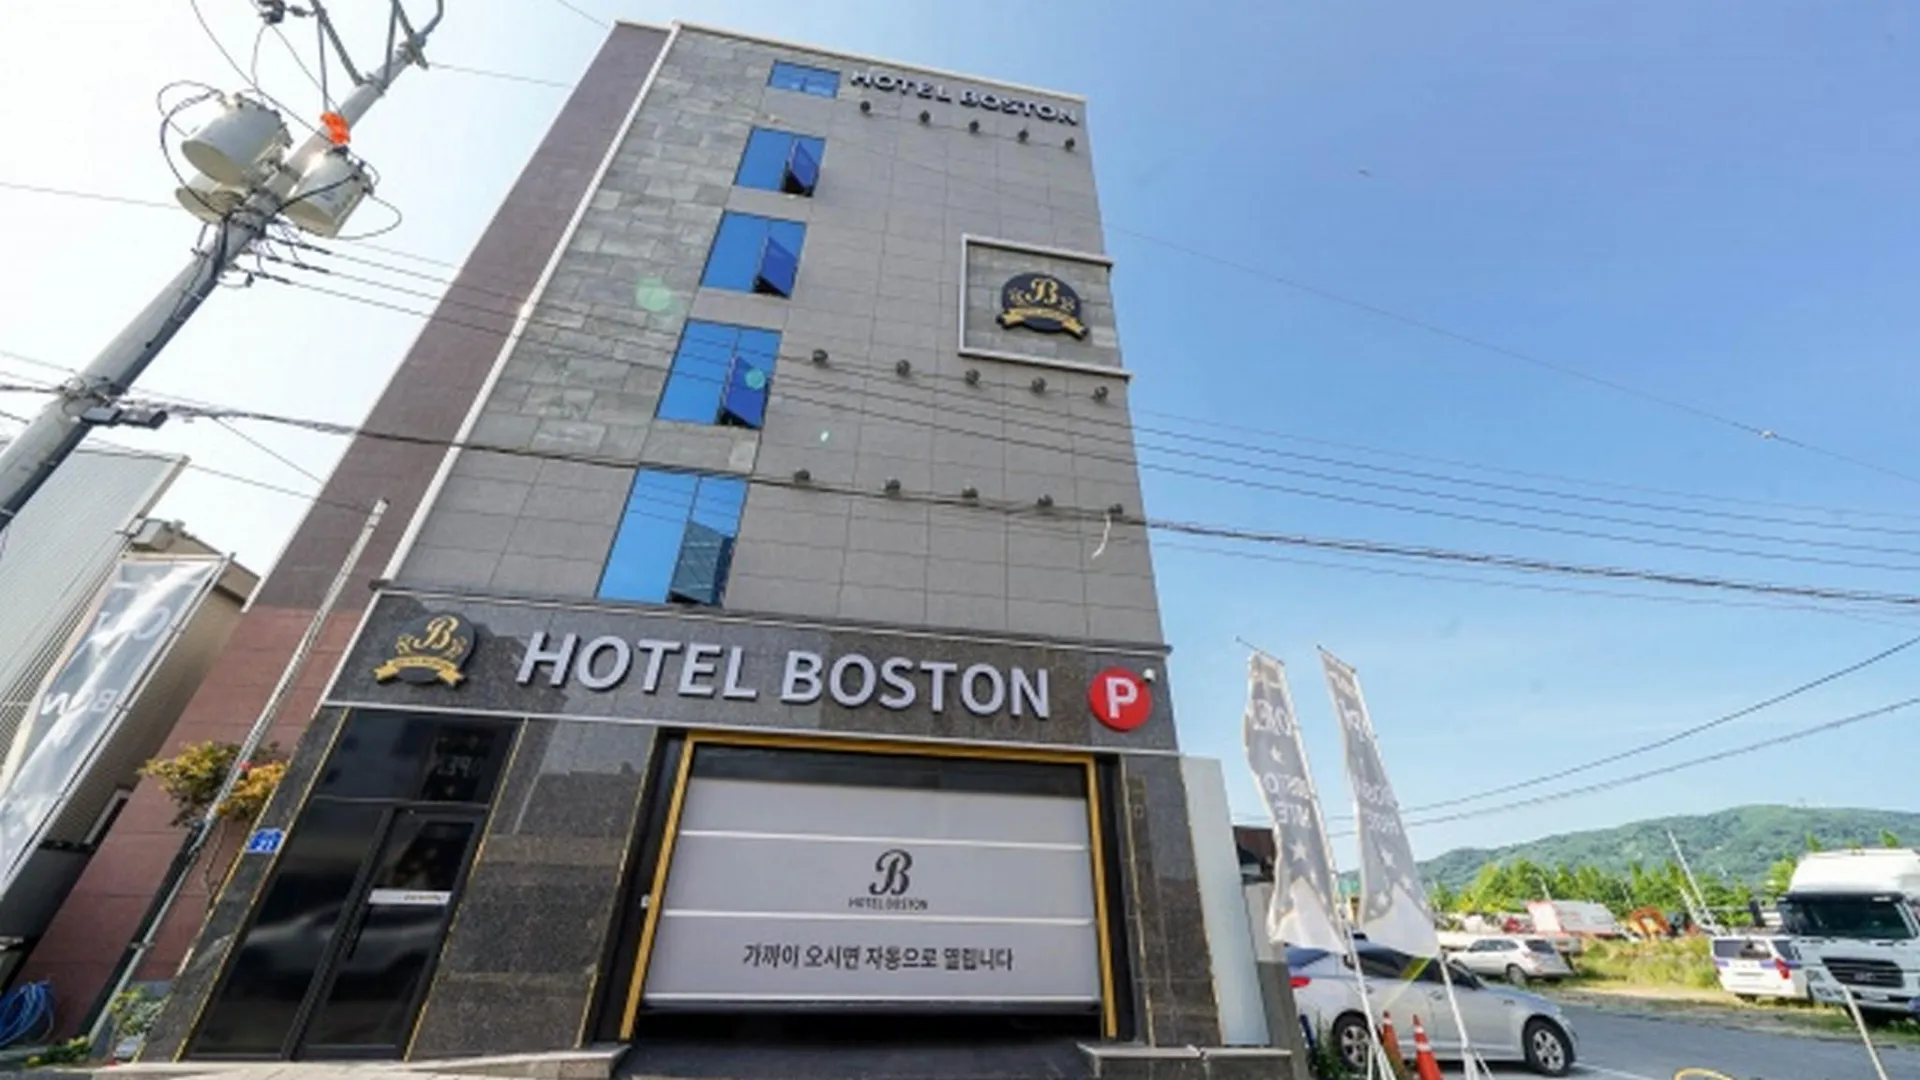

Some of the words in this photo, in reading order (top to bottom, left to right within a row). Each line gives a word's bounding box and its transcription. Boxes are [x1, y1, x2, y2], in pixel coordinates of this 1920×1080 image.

[850, 69, 952, 104] HOTEL
[959, 87, 1079, 127] BOSTON
[515, 631, 758, 701] HOTEL
[780, 650, 1051, 719] BOSTON
[1106, 677, 1139, 719] P
[868, 849, 913, 896] B
[848, 897, 884, 910] HOTEL
[886, 898, 929, 911] BOSTON
[743, 944, 800, 969] 가까이
[804, 944, 860, 970] 오시면
[864, 945, 938, 971] 자동으로
[944, 947, 1014, 971] 열립니다
